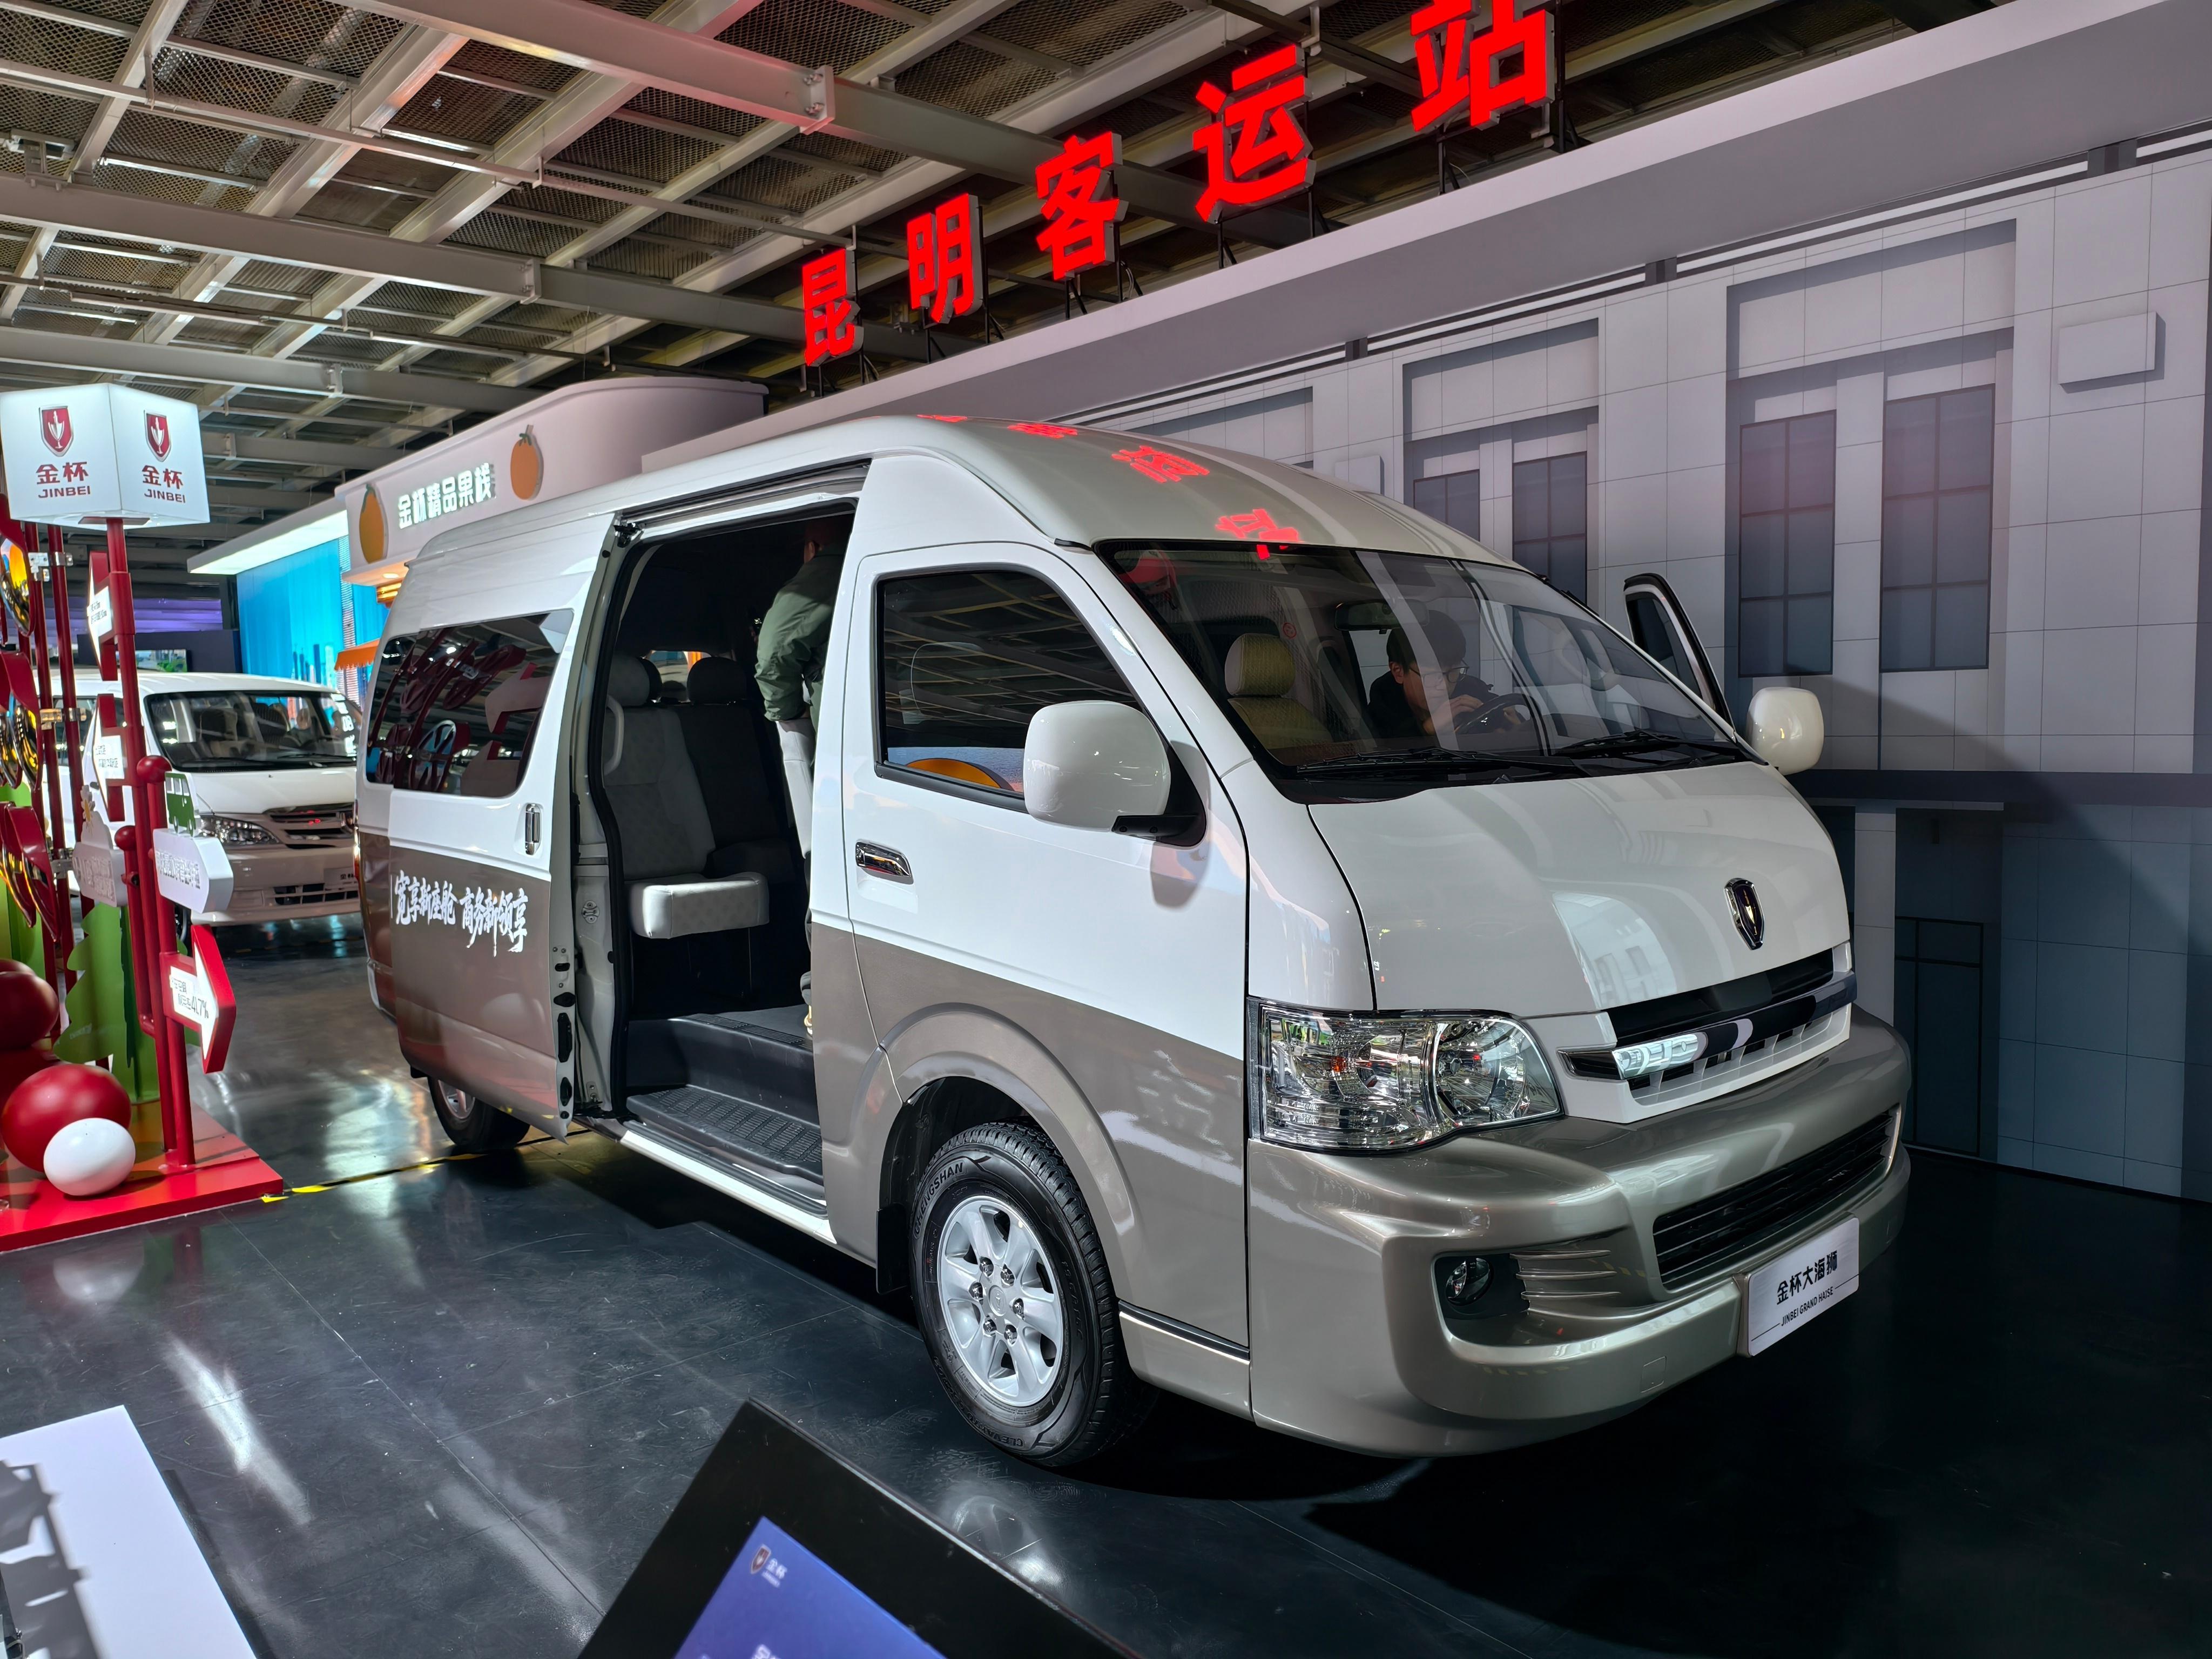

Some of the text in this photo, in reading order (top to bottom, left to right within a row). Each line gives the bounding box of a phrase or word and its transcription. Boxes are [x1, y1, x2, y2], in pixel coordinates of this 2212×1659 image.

[802, 0, 1546, 366] 昆明客运站
[36, 461, 89, 484] 金杯
[141, 465, 184, 489] 金杯
[38, 485, 91, 498] JINBEI
[144, 489, 186, 503] JINBEI
[914, 1162, 963, 1235] CHENGSHAN
[1776, 1250, 1838, 1305] 金杯大海狮
[1781, 1286, 1833, 1326] JINBEI GRAND HAISE
